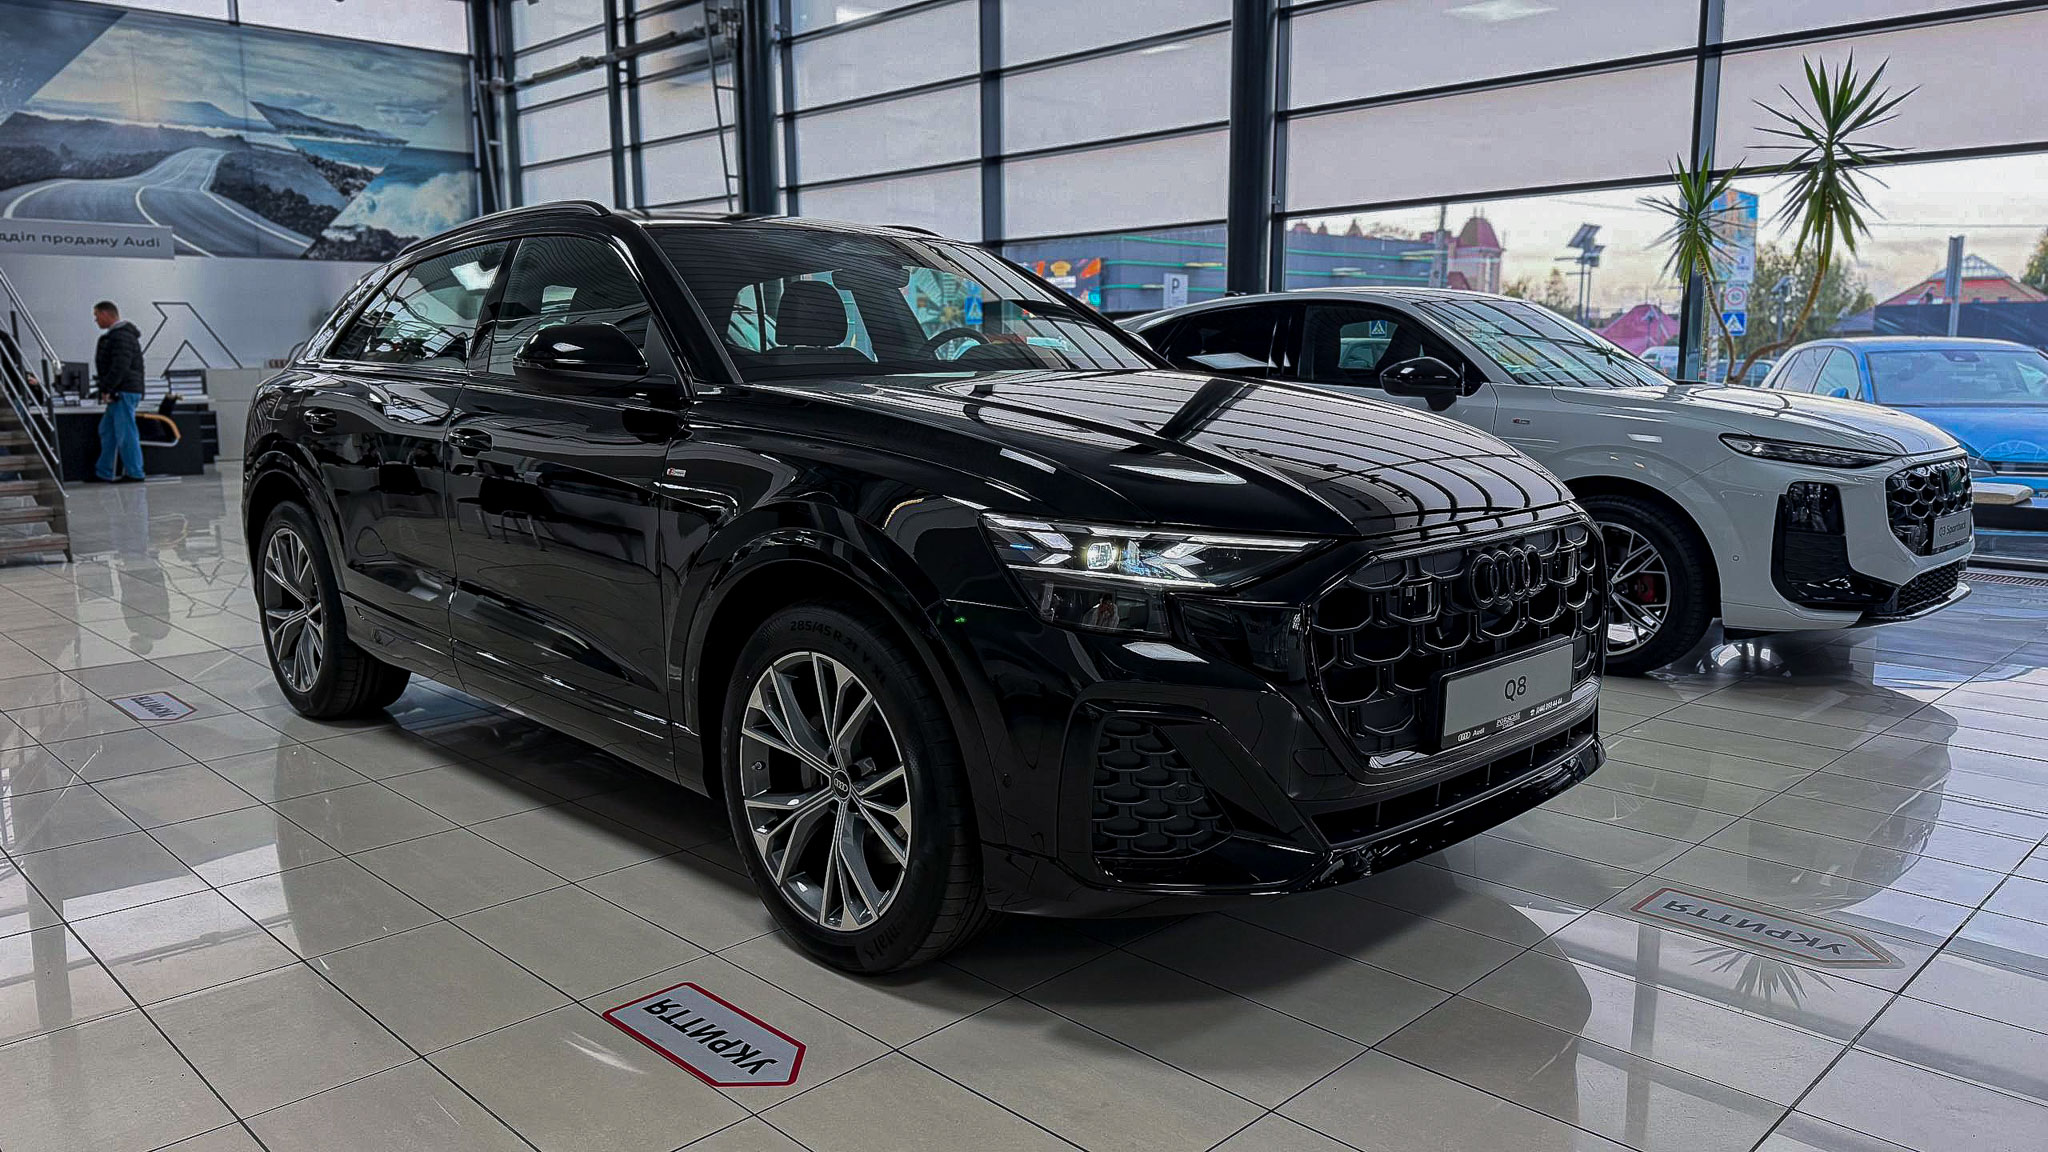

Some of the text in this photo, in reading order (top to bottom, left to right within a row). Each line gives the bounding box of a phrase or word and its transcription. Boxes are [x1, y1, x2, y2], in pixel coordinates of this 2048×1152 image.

[41, 233, 118, 248] продажу
[123, 236, 161, 248] Audi
[790, 620, 832, 637] 285/45
[832, 631, 842, 641] R
[1504, 675, 1527, 702] Q8
[1472, 727, 1485, 737] Audi
[1662, 900, 1847, 956] УКРИТТЯ
[642, 998, 779, 1075] УКРИТТЯ
